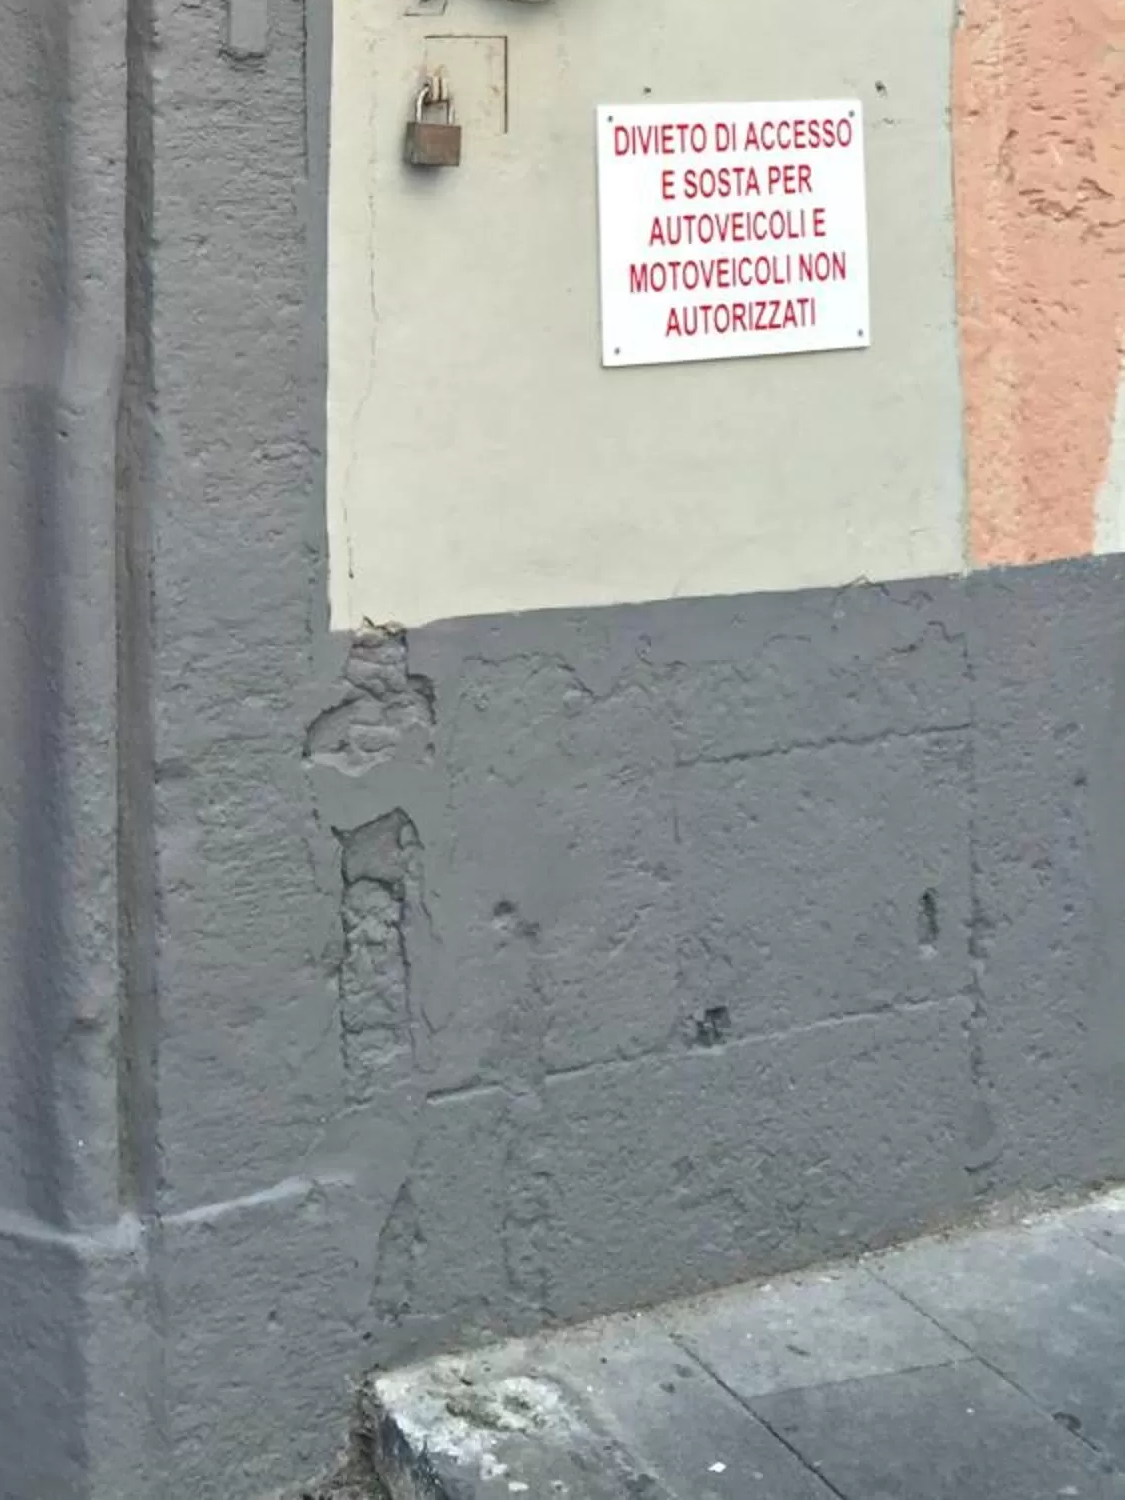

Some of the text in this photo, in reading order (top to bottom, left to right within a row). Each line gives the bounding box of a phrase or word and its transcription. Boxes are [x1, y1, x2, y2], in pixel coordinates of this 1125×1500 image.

[614, 118, 853, 156] DIVIETO DI ACCESSO
[661, 164, 813, 200] E SOSTA PER
[649, 207, 826, 246] AUTOVEICOLI E
[629, 251, 847, 294] MOTOVEICOLI NON
[665, 297, 817, 338] AUTORIZZATI
